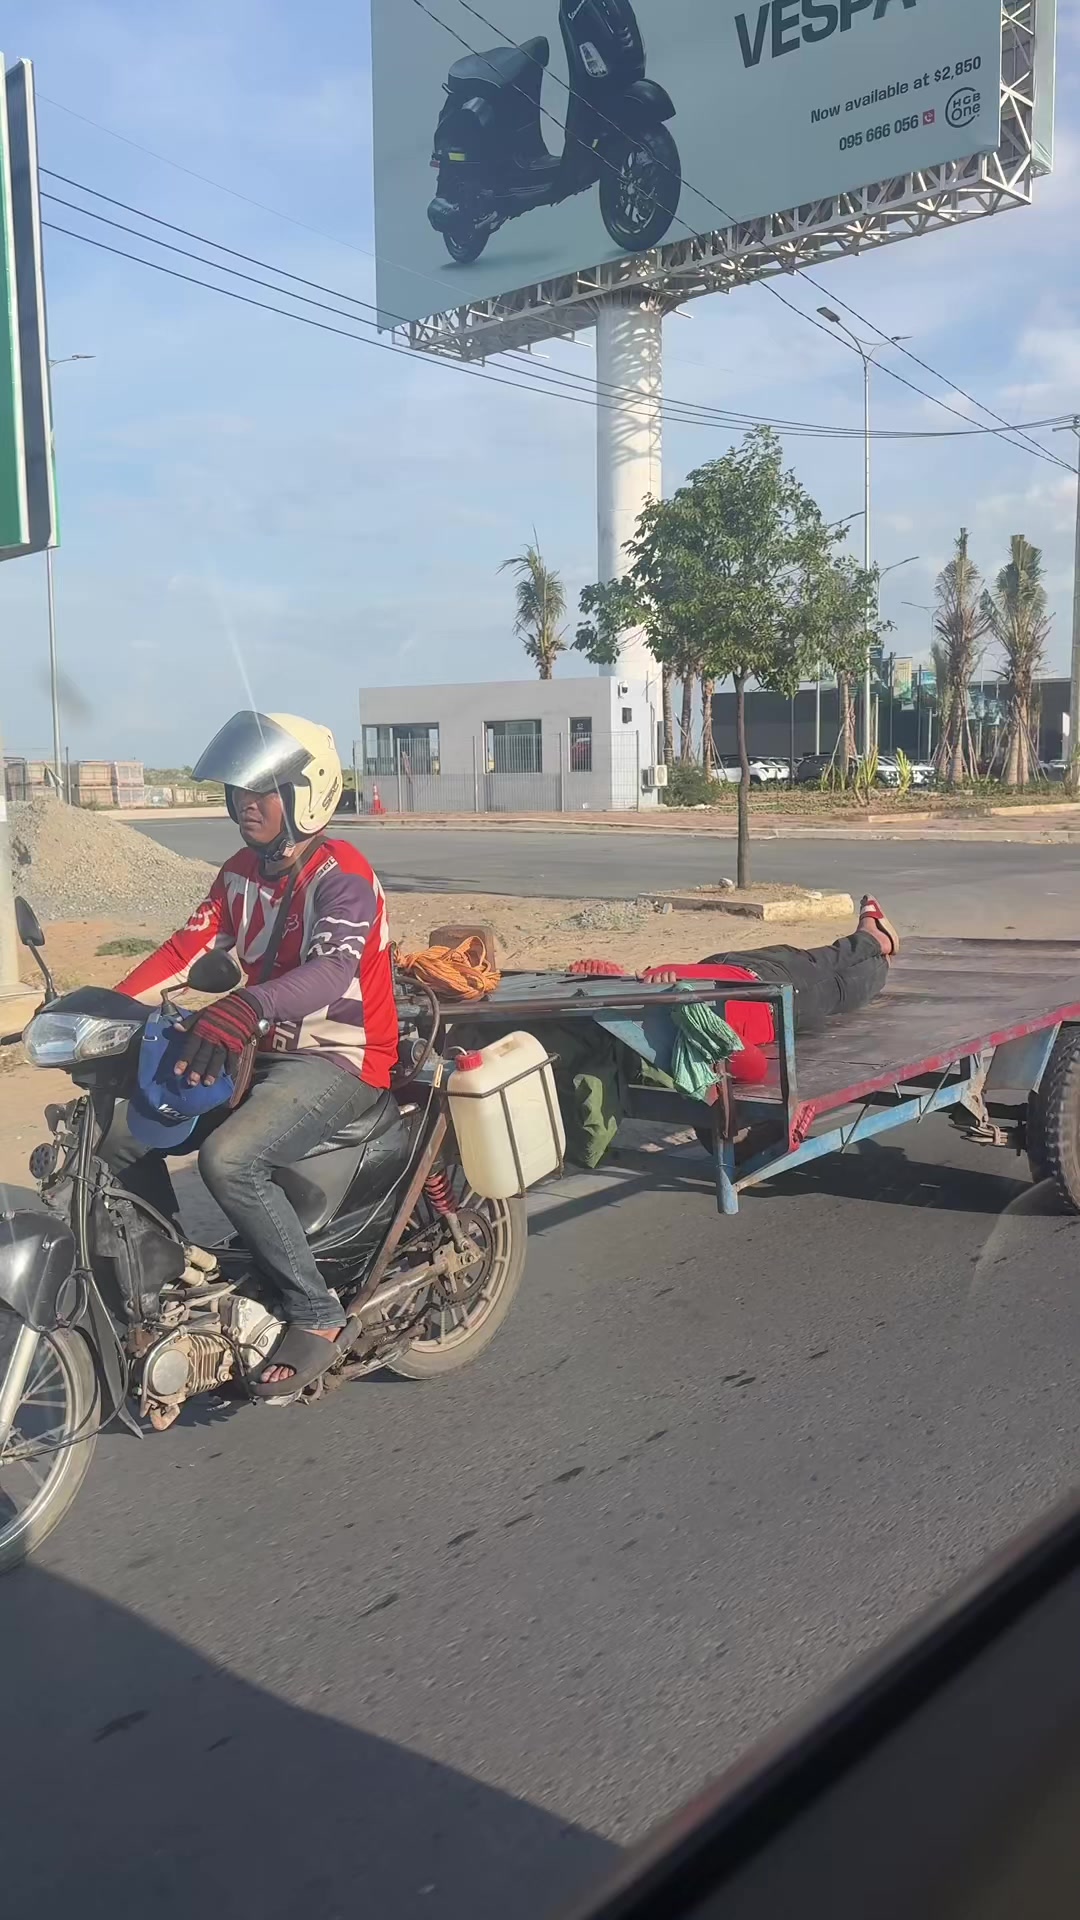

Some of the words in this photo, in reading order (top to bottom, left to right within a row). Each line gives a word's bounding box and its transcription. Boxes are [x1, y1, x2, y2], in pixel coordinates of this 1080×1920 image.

[810, 104, 841, 123] Now
[845, 82, 909, 112] available
[913, 73, 930, 90] at
[934, 56, 982, 82] $2,850
[952, 93, 981, 108] HGB
[951, 103, 981, 121] One
[839, 131, 863, 151] 095
[866, 123, 891, 142] 666
[894, 114, 919, 134] 056
